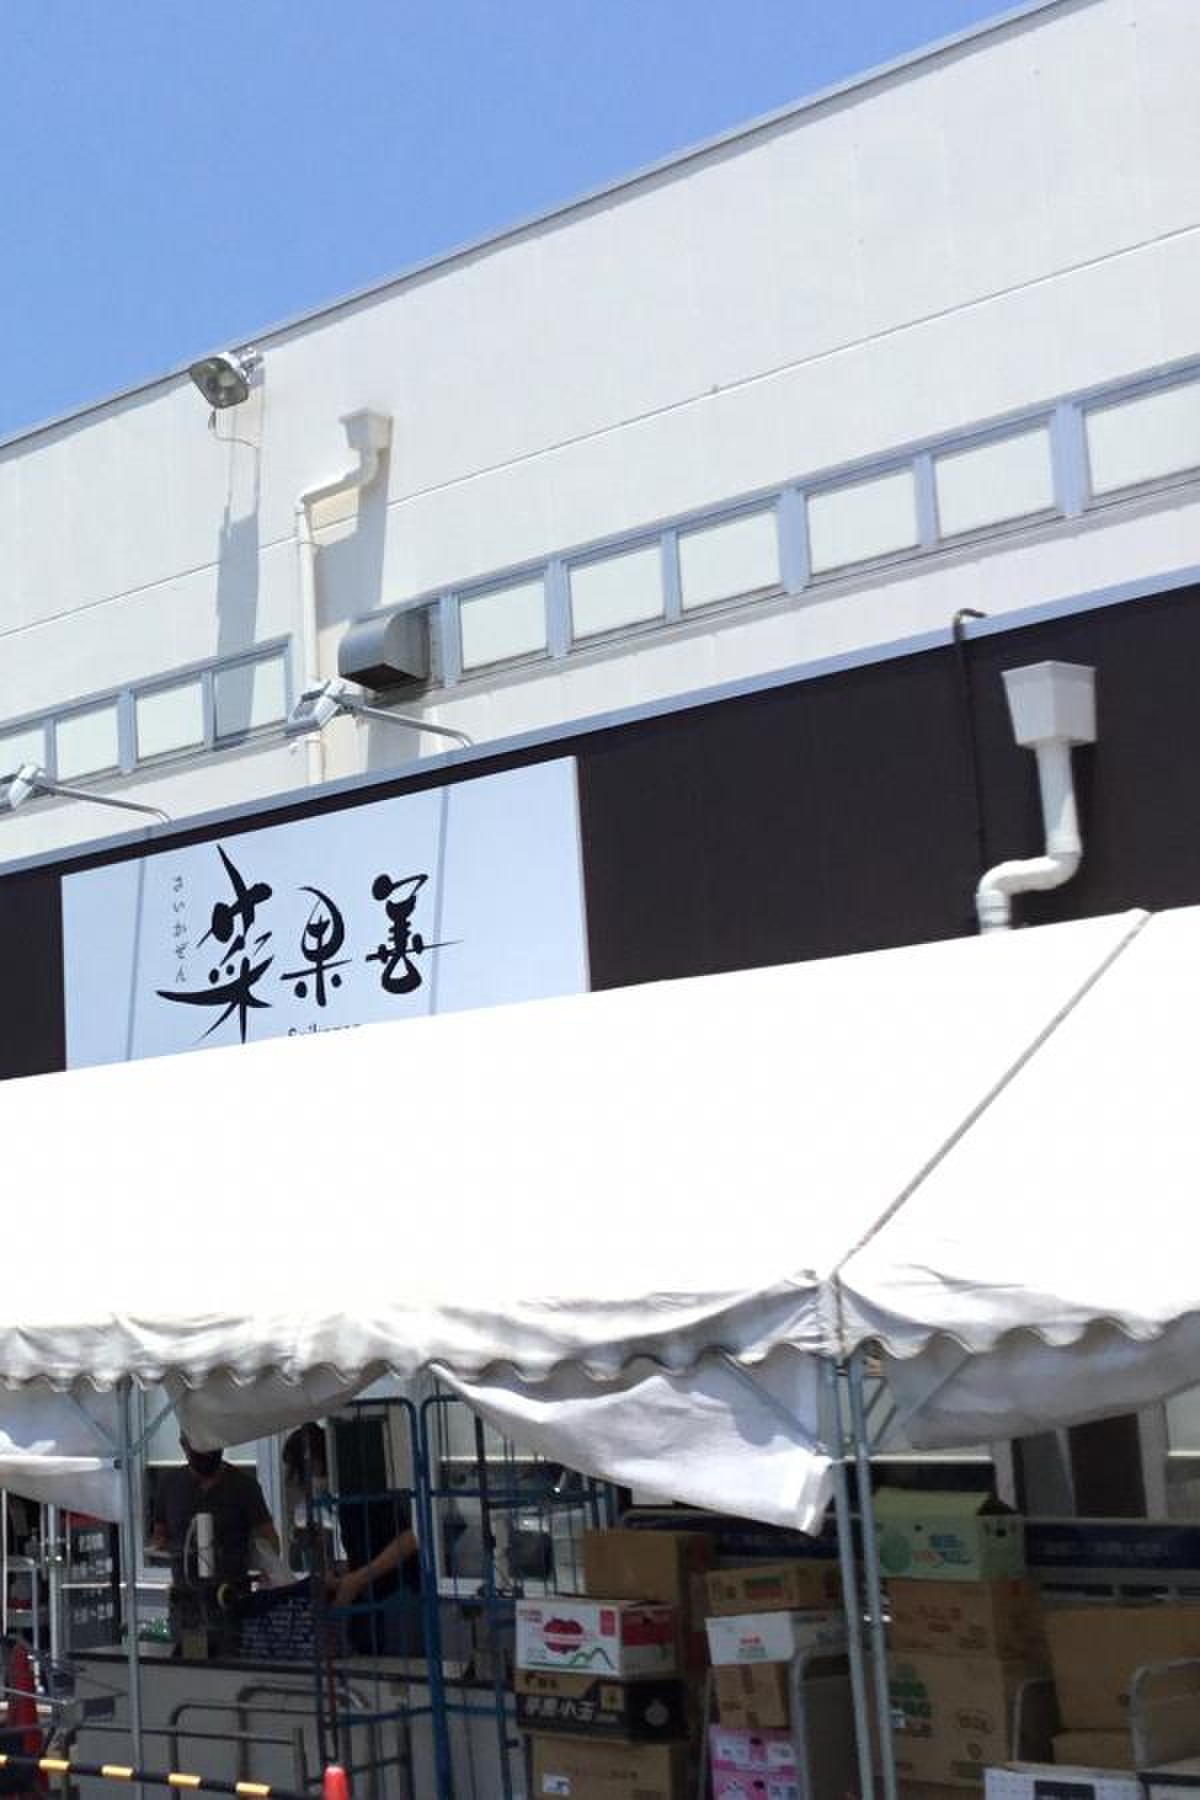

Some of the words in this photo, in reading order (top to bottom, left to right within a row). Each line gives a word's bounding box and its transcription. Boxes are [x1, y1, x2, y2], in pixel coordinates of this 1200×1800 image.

[155, 843, 465, 1044] 菜果善
[172, 875, 188, 984] さいかぜん
